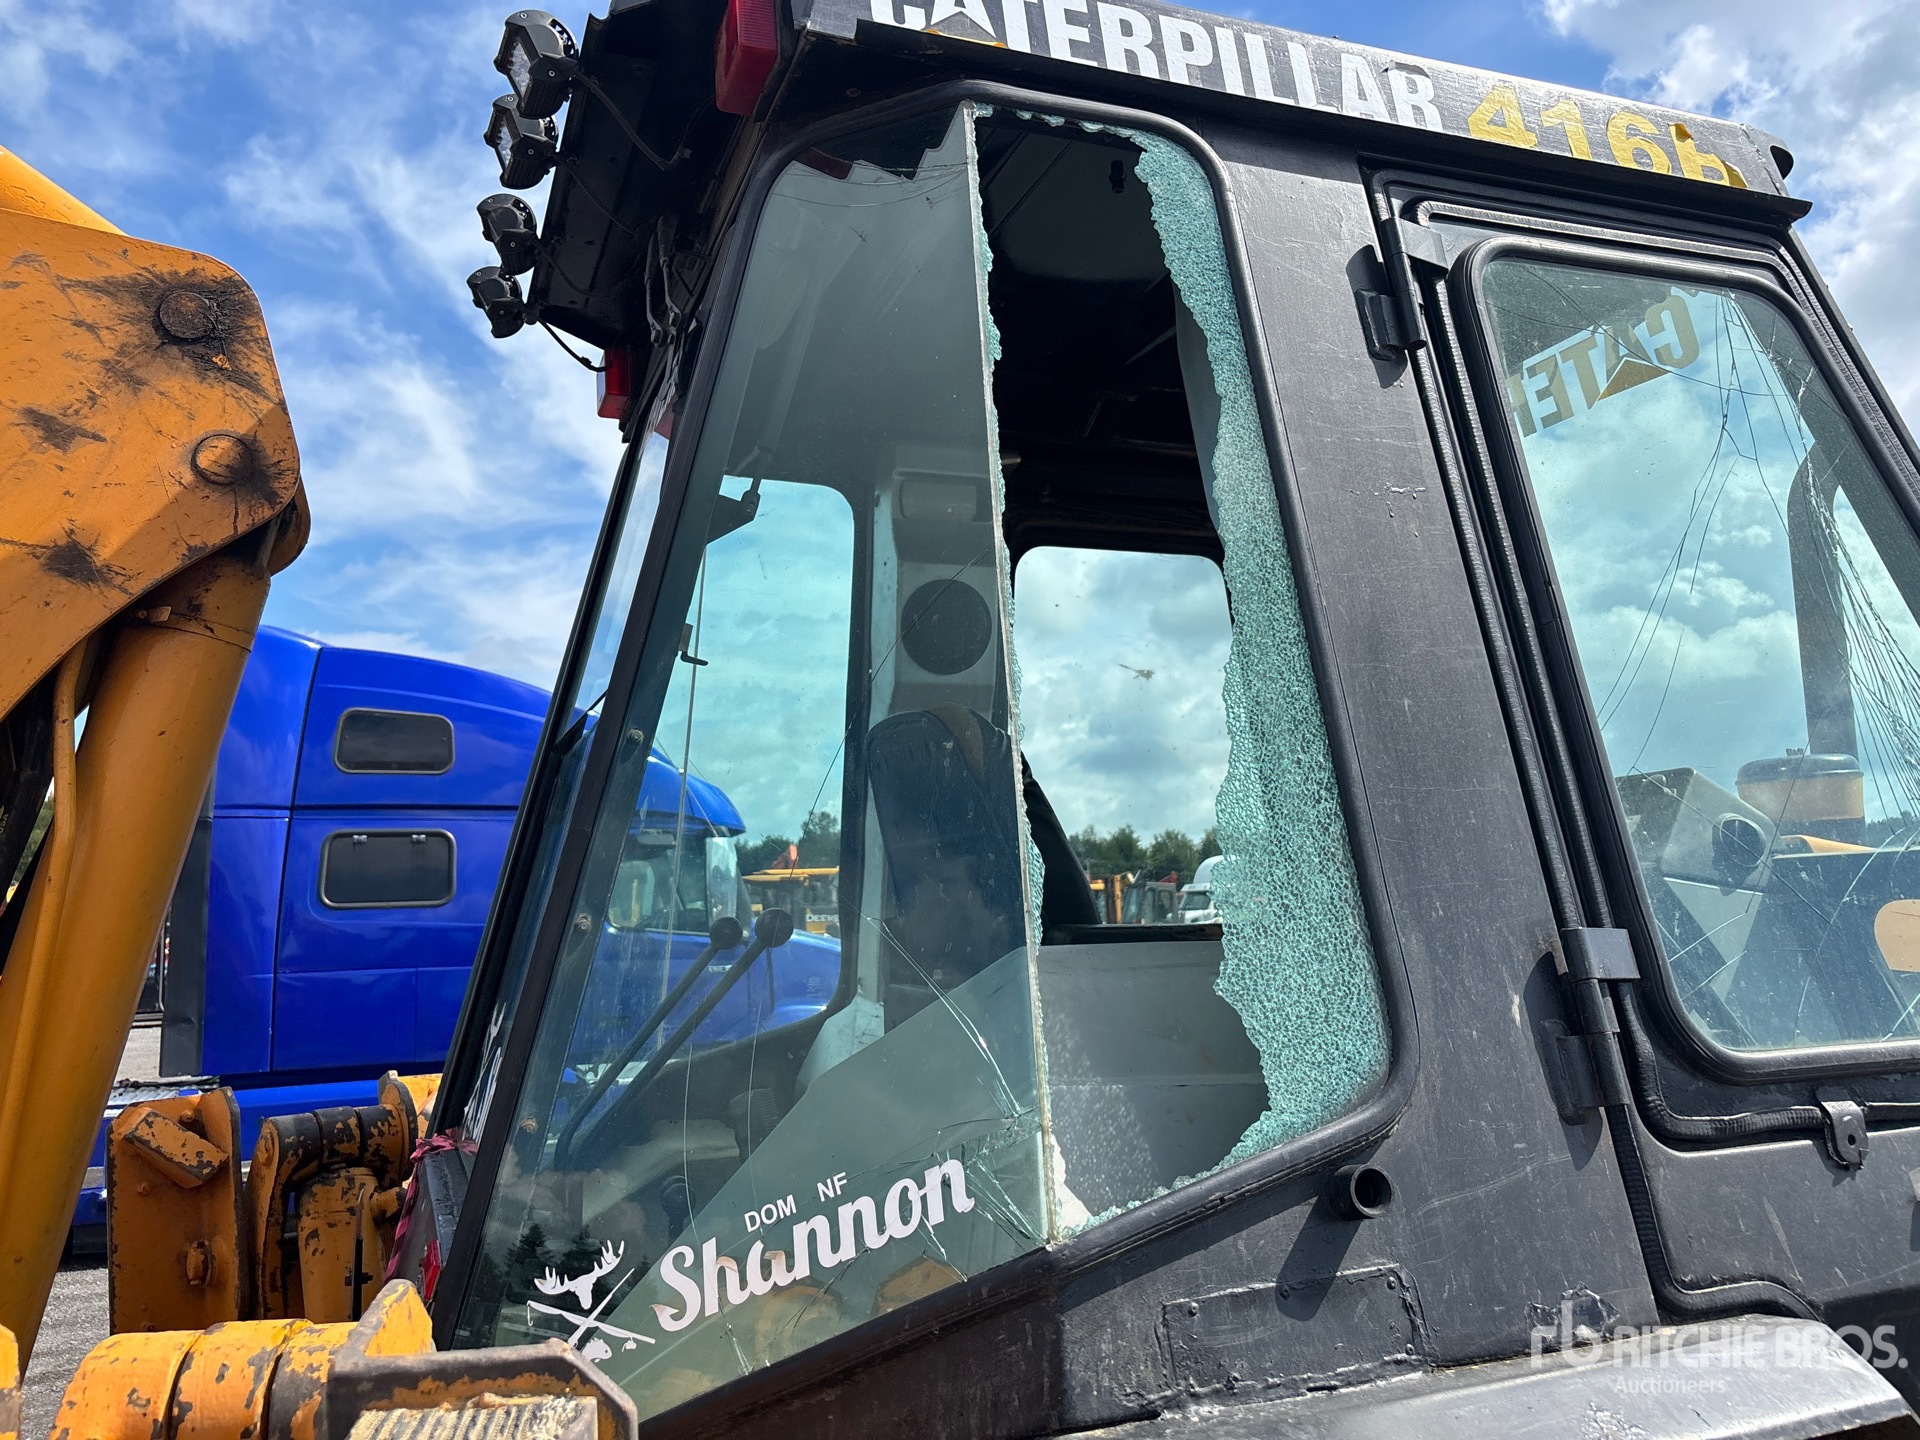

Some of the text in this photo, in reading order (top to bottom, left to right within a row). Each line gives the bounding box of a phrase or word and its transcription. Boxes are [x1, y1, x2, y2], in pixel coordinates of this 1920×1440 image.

[649, 1158, 975, 1332] Shannon
[743, 1171, 849, 1233] DOM NF
